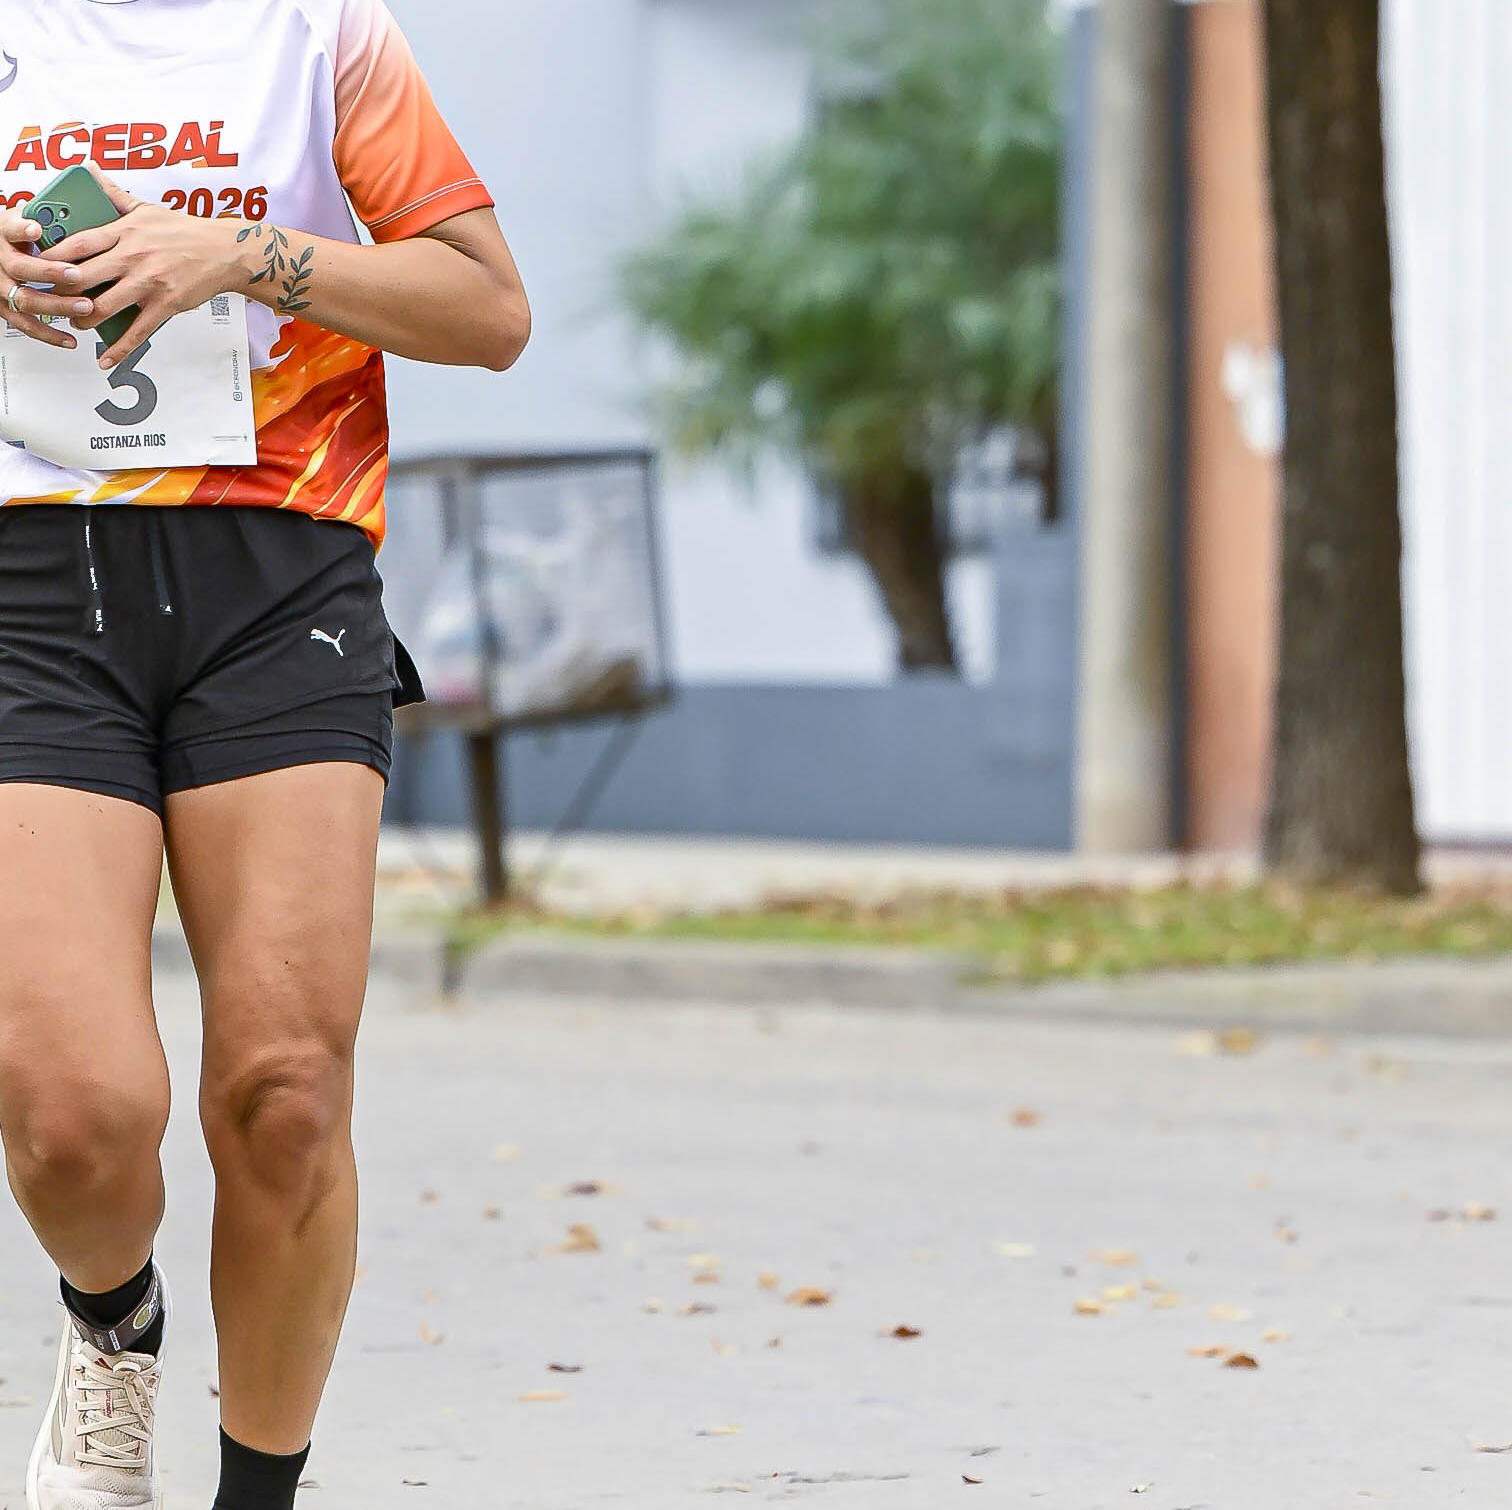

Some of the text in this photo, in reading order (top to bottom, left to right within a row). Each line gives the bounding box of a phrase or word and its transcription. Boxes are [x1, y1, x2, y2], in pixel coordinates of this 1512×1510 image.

[4, 121, 238, 171] ACEBAL
[161, 186, 268, 221] 2026
[94, 339, 158, 426] 3
[90, 434, 166, 450] COSTANZA RIOS
